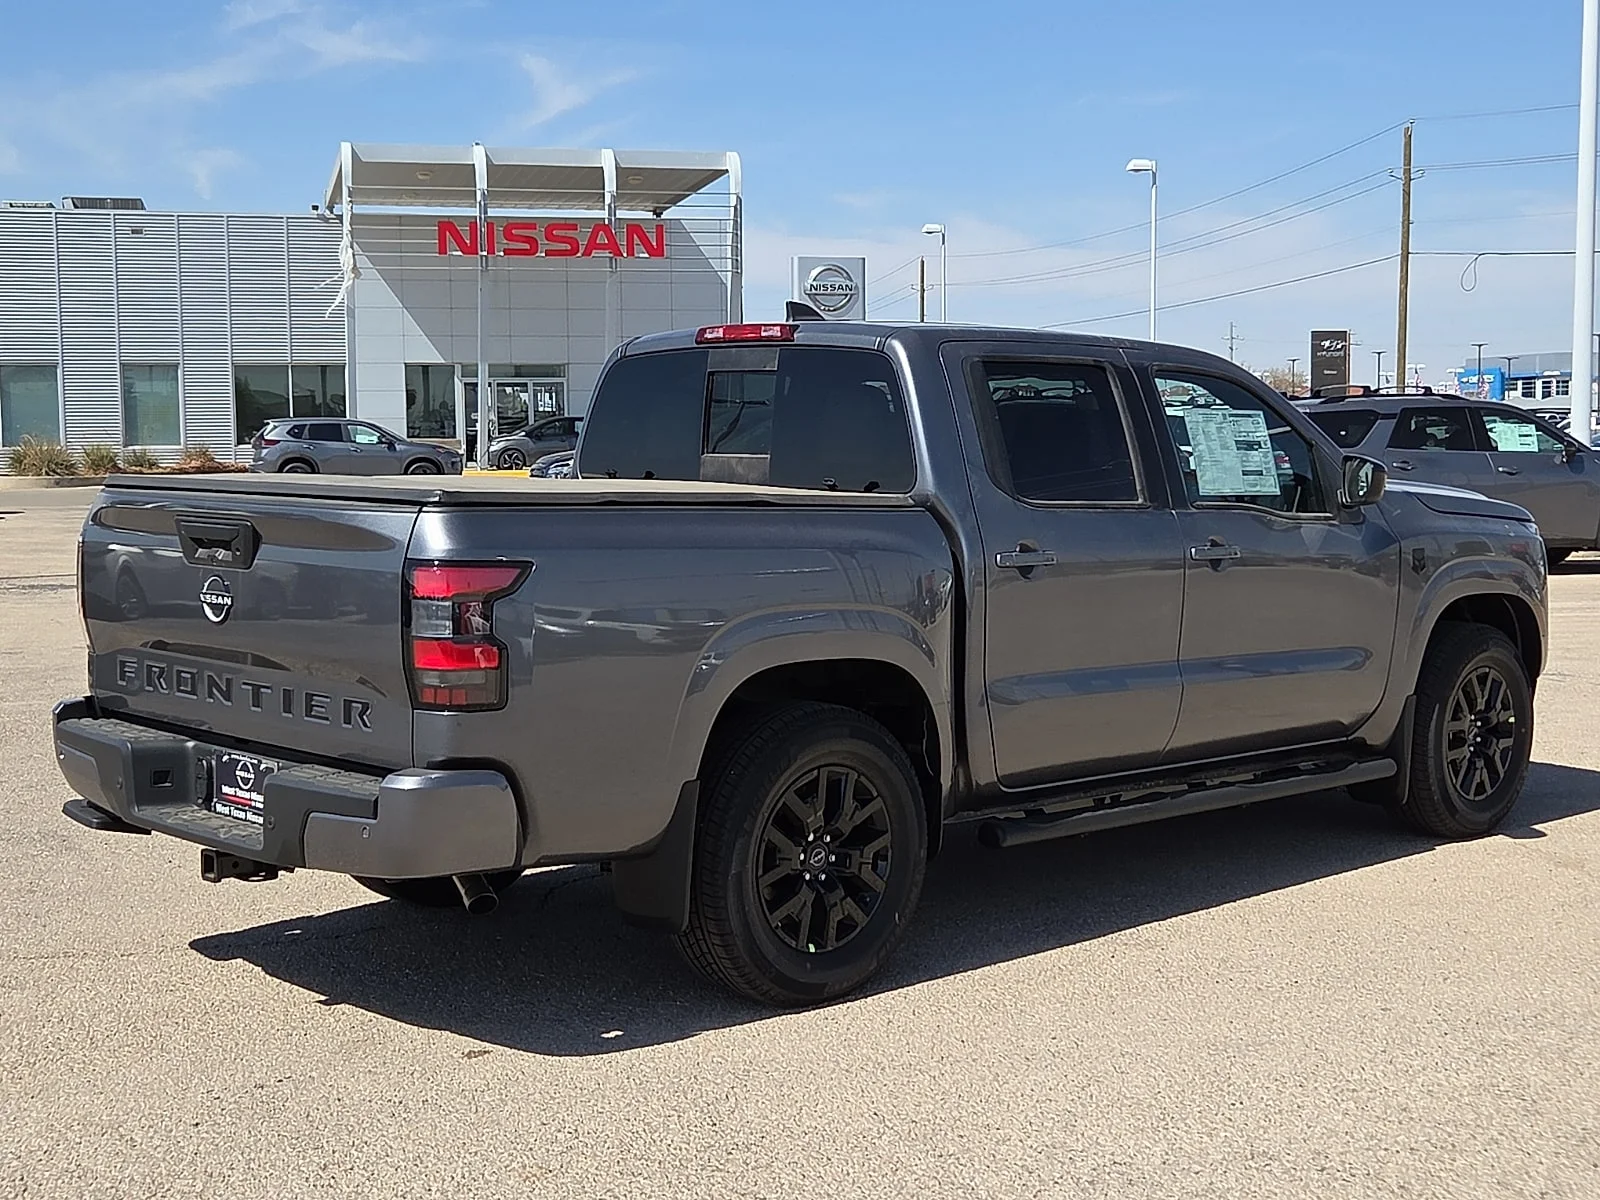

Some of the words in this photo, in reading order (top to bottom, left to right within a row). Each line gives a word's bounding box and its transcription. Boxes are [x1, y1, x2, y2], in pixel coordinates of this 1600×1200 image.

[437, 220, 666, 258] NISSAN
[809, 283, 853, 292] NISSAN
[116, 655, 373, 733] FRONTIER
[215, 802, 230, 815] West
